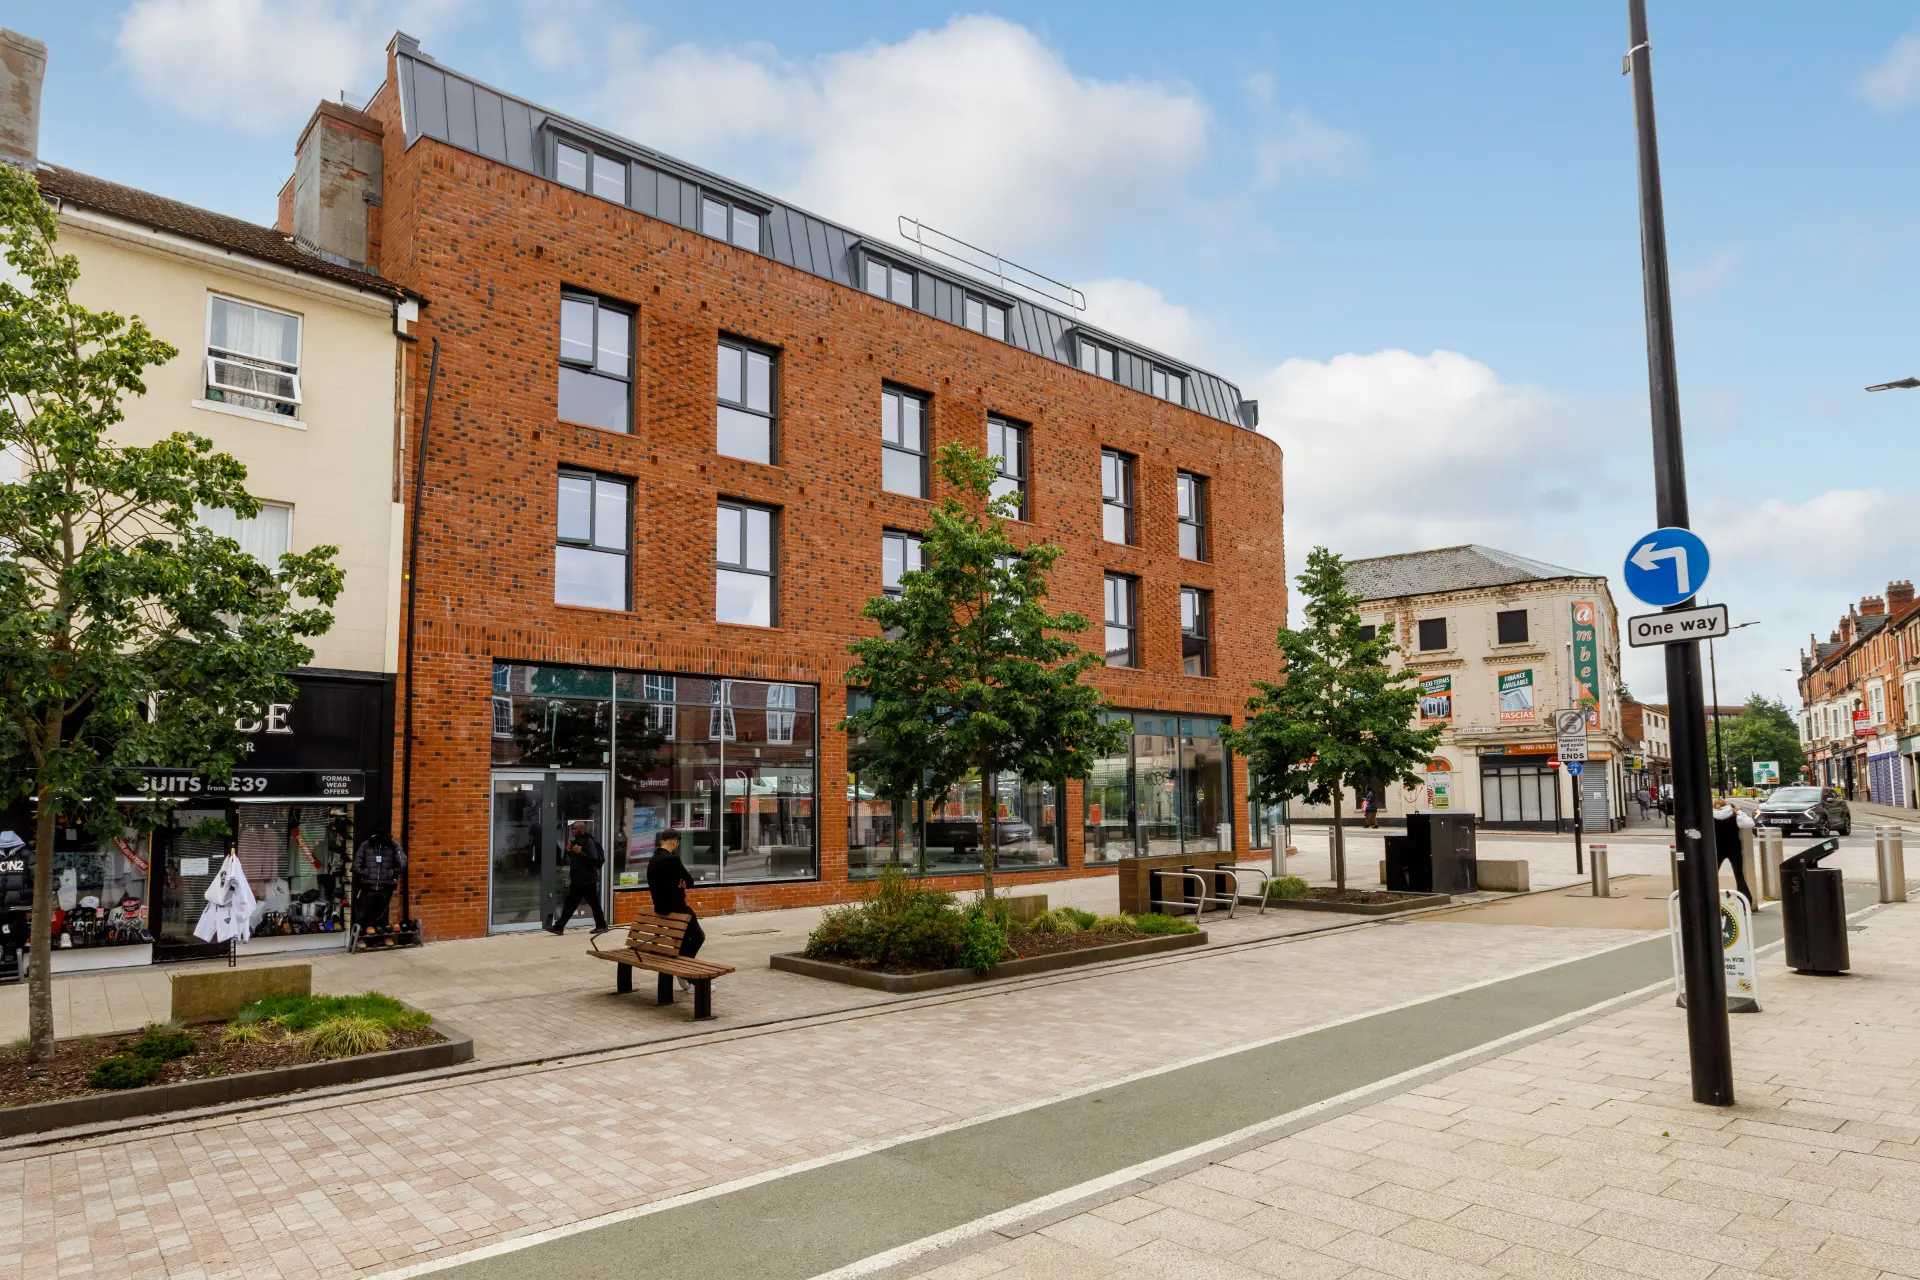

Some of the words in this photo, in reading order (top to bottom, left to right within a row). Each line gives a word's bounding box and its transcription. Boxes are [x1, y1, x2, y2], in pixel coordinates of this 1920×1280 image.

[1638, 623, 1674, 637] One
[1680, 617, 1718, 631] way
[1575, 605, 1592, 694] amber
[1434, 676, 1450, 687] TERMS
[1504, 672, 1526, 682] FINANCE
[1502, 678, 1529, 690] AVAILABLE
[1501, 711, 1534, 719] FASCIAS
[136, 776, 201, 792] SUITS
[207, 784, 226, 792] from
[229, 777, 268, 792] £39
